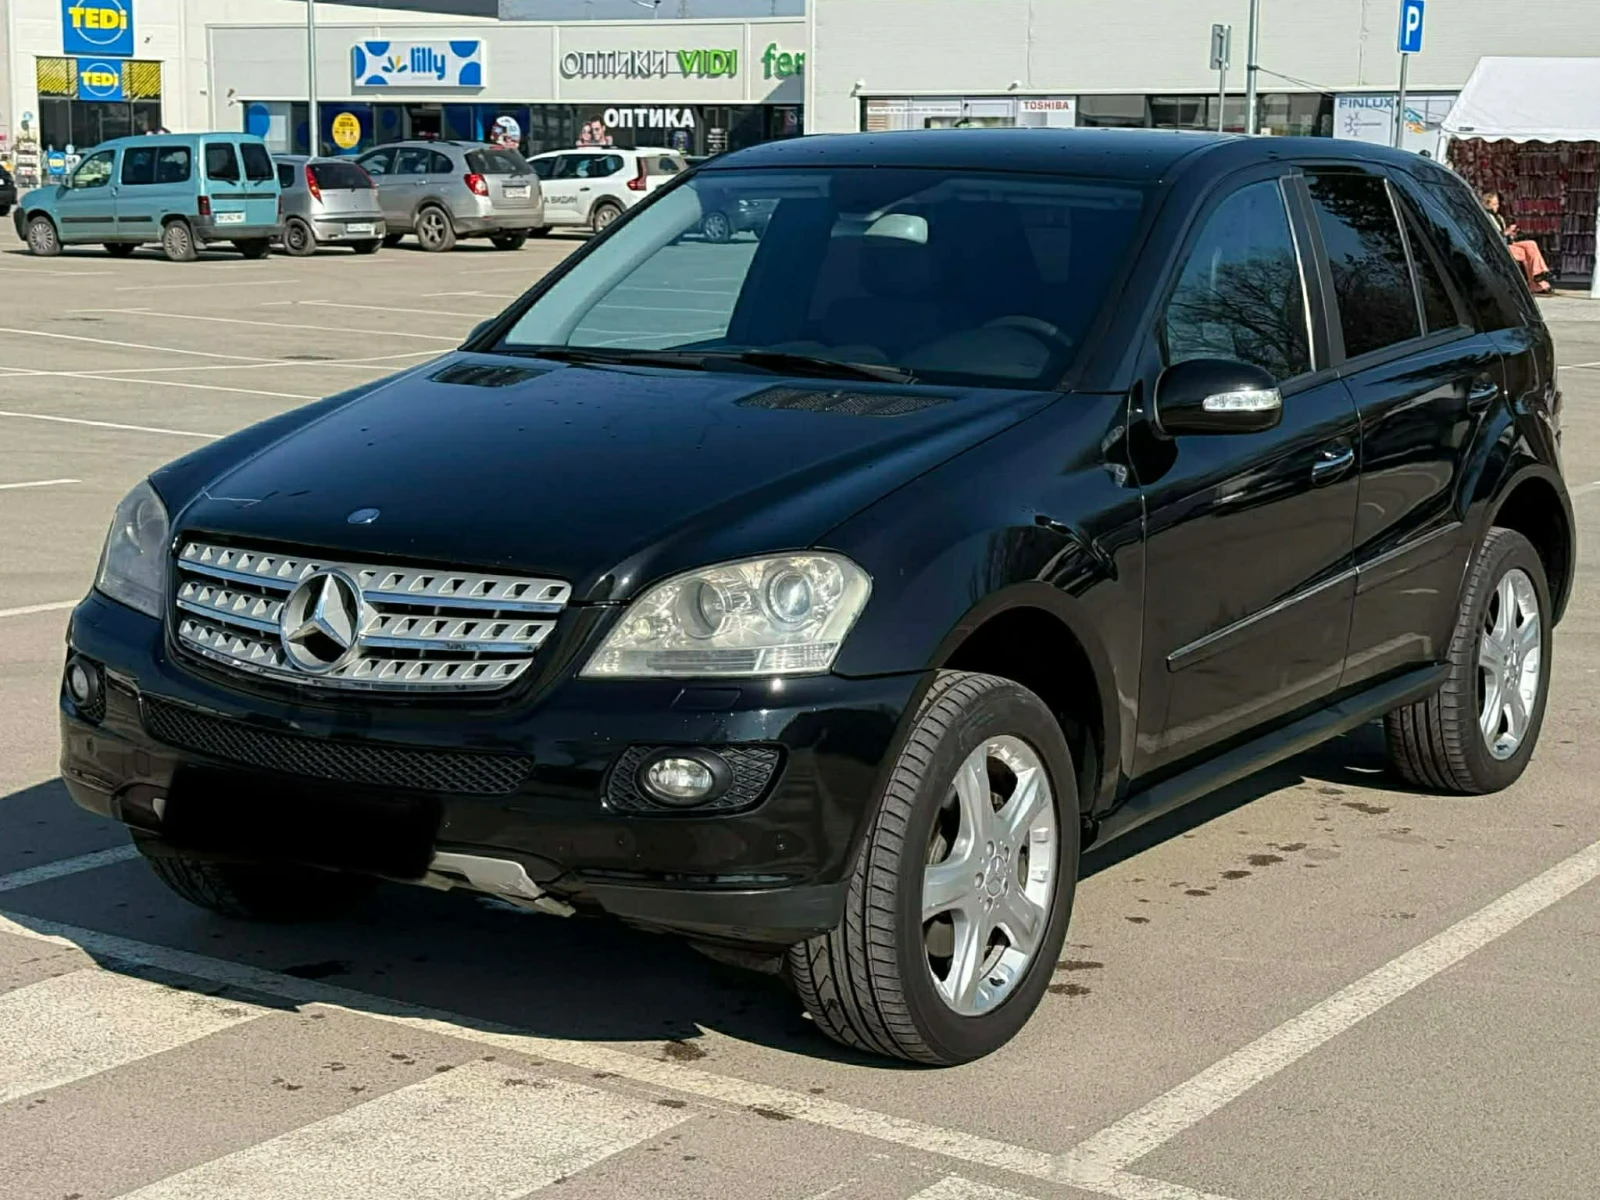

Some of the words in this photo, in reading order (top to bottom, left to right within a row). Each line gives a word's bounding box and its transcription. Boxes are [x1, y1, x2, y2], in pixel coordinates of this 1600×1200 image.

[68, 7, 128, 30] TEDi
[1404, 5, 1421, 46] P
[410, 46, 447, 81] lilly
[560, 49, 669, 78] ОПТИКИ
[677, 49, 738, 77] VIDI
[80, 71, 119, 87] TEDi
[1023, 100, 1070, 111] TOSHIBA
[1338, 97, 1394, 110] FINLUX
[603, 108, 695, 129] ОПТИКА
